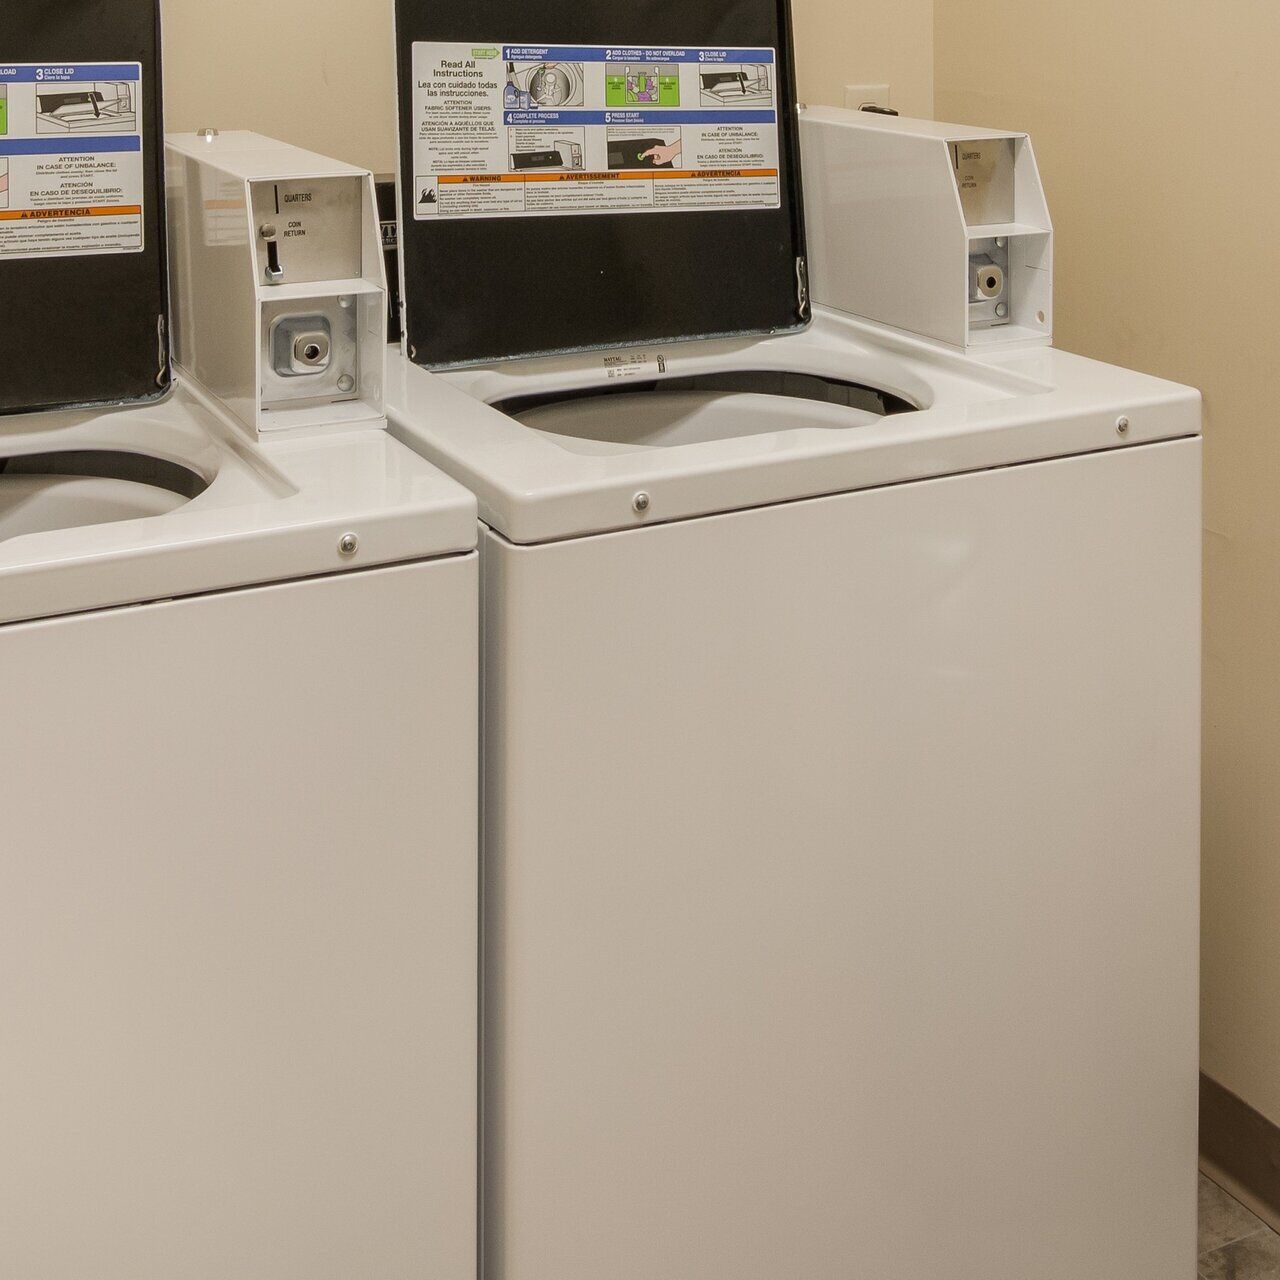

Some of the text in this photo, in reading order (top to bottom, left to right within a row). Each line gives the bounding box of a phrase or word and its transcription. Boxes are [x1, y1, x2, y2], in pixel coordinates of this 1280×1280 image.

[506, 49, 510, 58] 1
[605, 50, 612, 60] 2
[699, 52, 705, 61] 3
[441, 60, 475, 68] Read All
[36, 68, 44, 81] 3
[433, 69, 483, 78] Instructions
[450, 81, 477, 89] cuidado
[478, 81, 498, 89] todas
[427, 89, 489, 97] las instrucciones.
[507, 113, 513, 123] 4
[605, 112, 612, 123] 5
[284, 192, 312, 203] QUARTERS
[30, 208, 91, 218] ADVERTENCIA
[287, 221, 302, 229] COIN
[283, 229, 306, 238] RETURN
